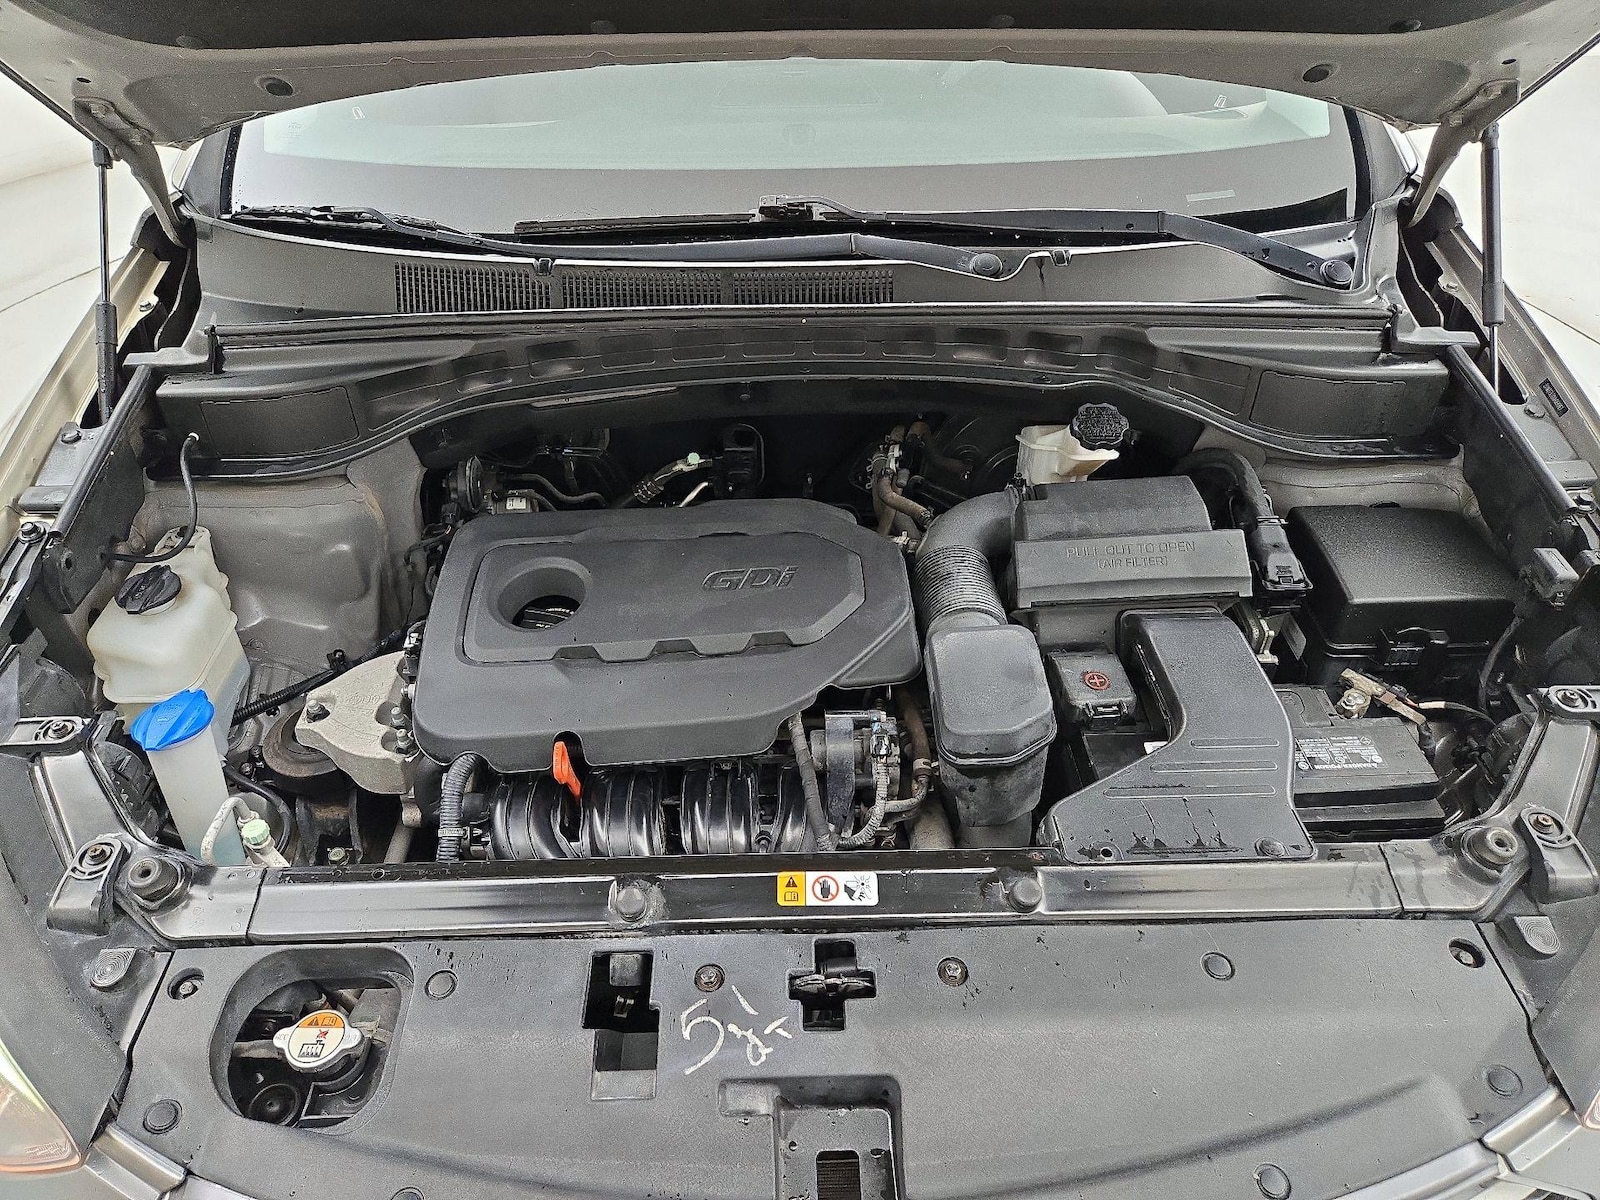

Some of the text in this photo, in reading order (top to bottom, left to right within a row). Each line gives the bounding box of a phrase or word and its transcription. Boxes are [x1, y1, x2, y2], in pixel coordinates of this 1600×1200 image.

[1066, 541, 1196, 559] PULL OUT TO OPEN
[1124, 556, 1169, 569] FILTER)
